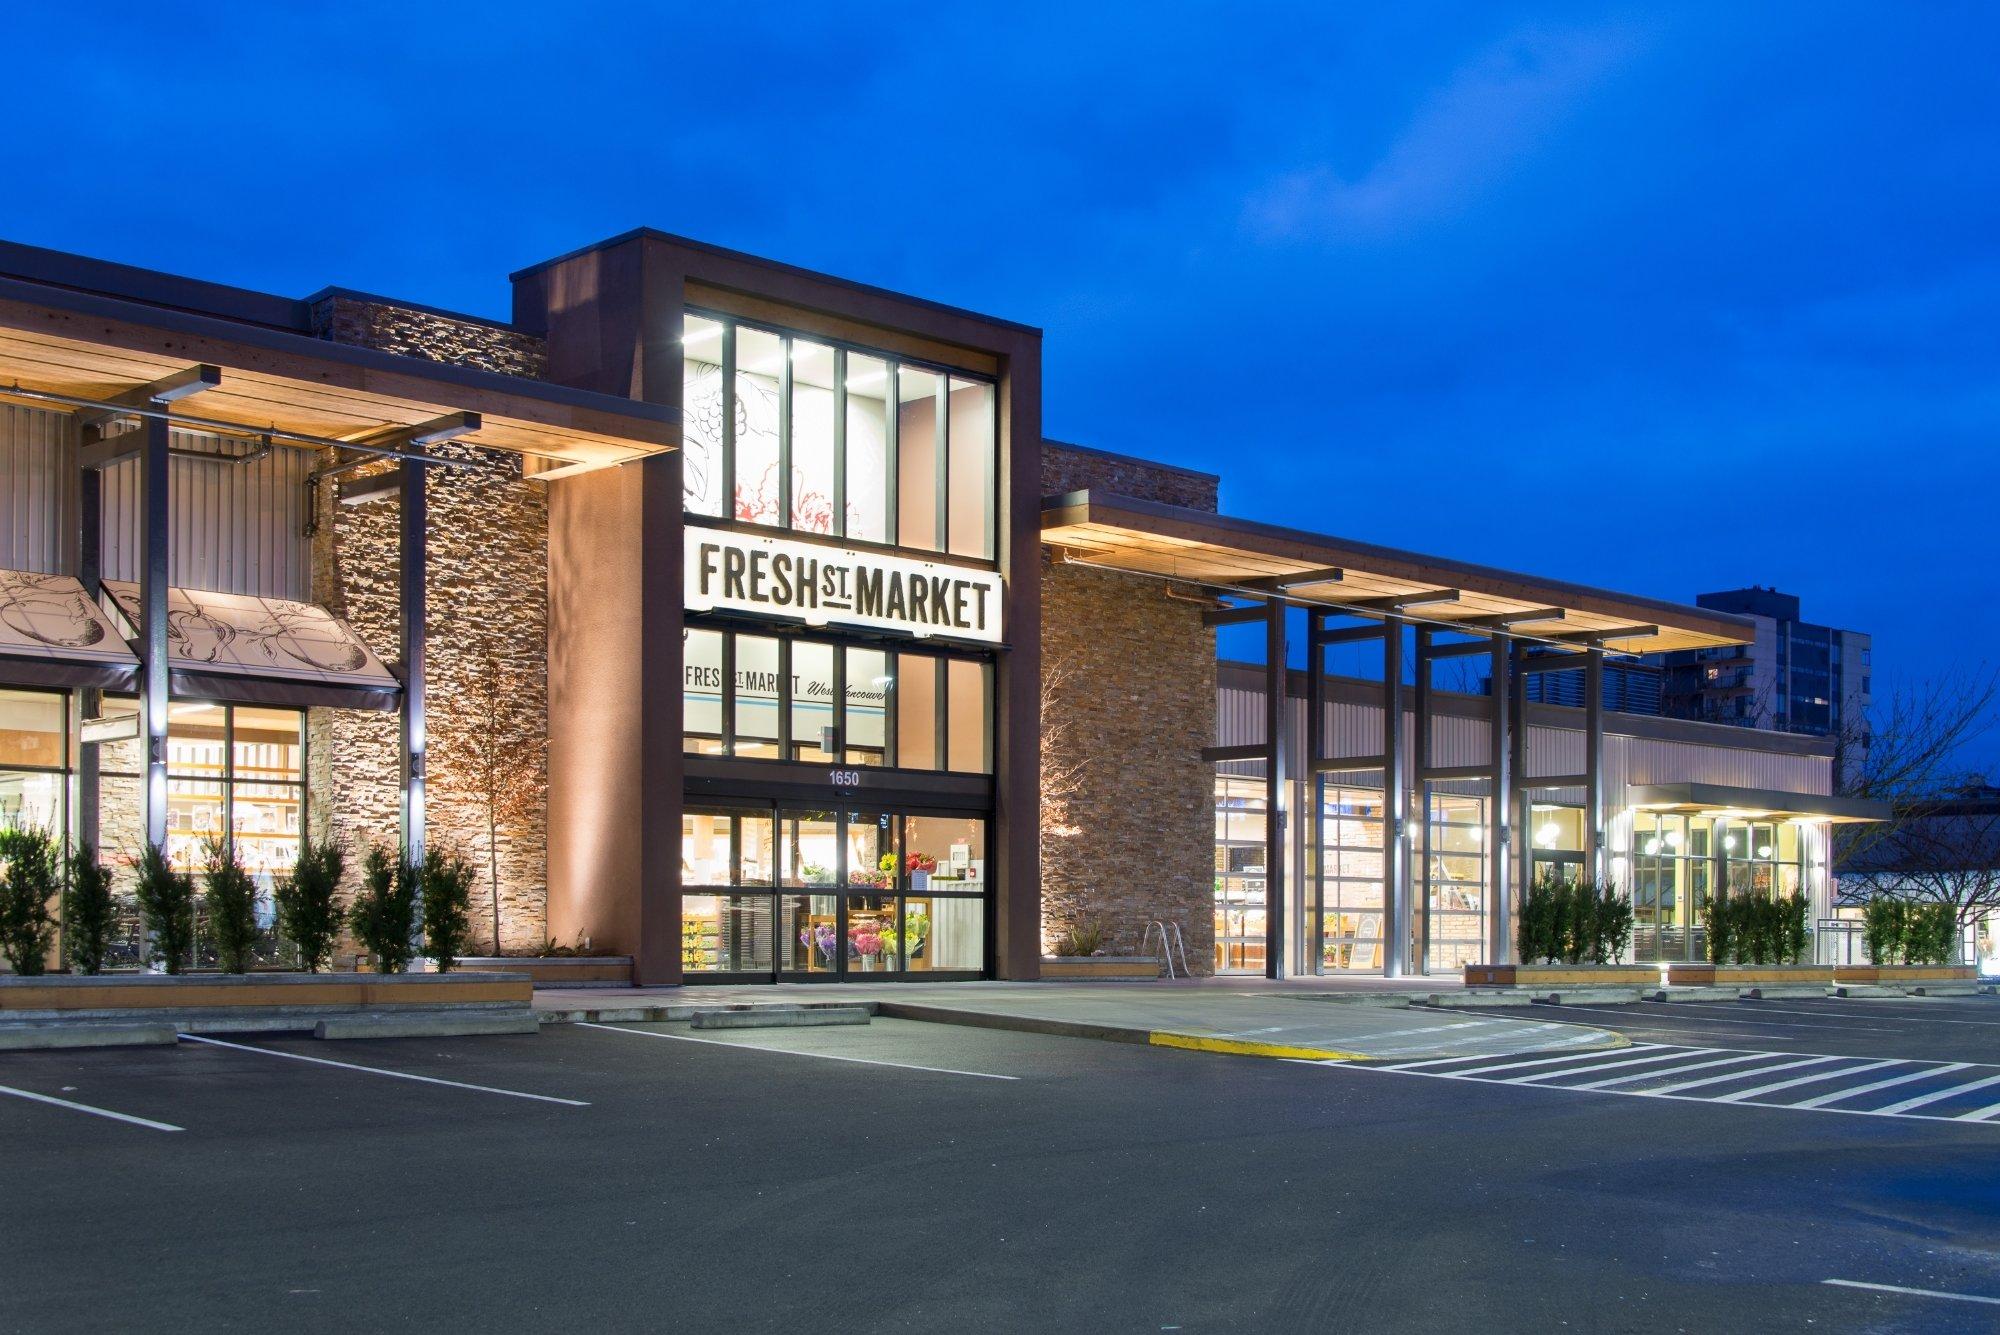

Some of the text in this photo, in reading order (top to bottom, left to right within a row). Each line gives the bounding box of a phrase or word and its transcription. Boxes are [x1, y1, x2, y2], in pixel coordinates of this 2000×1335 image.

[700, 542, 991, 631] FRESH ST. MARKET
[685, 665, 721, 687] FRES
[746, 671, 800, 694] MART
[830, 770, 859, 786] 1650
